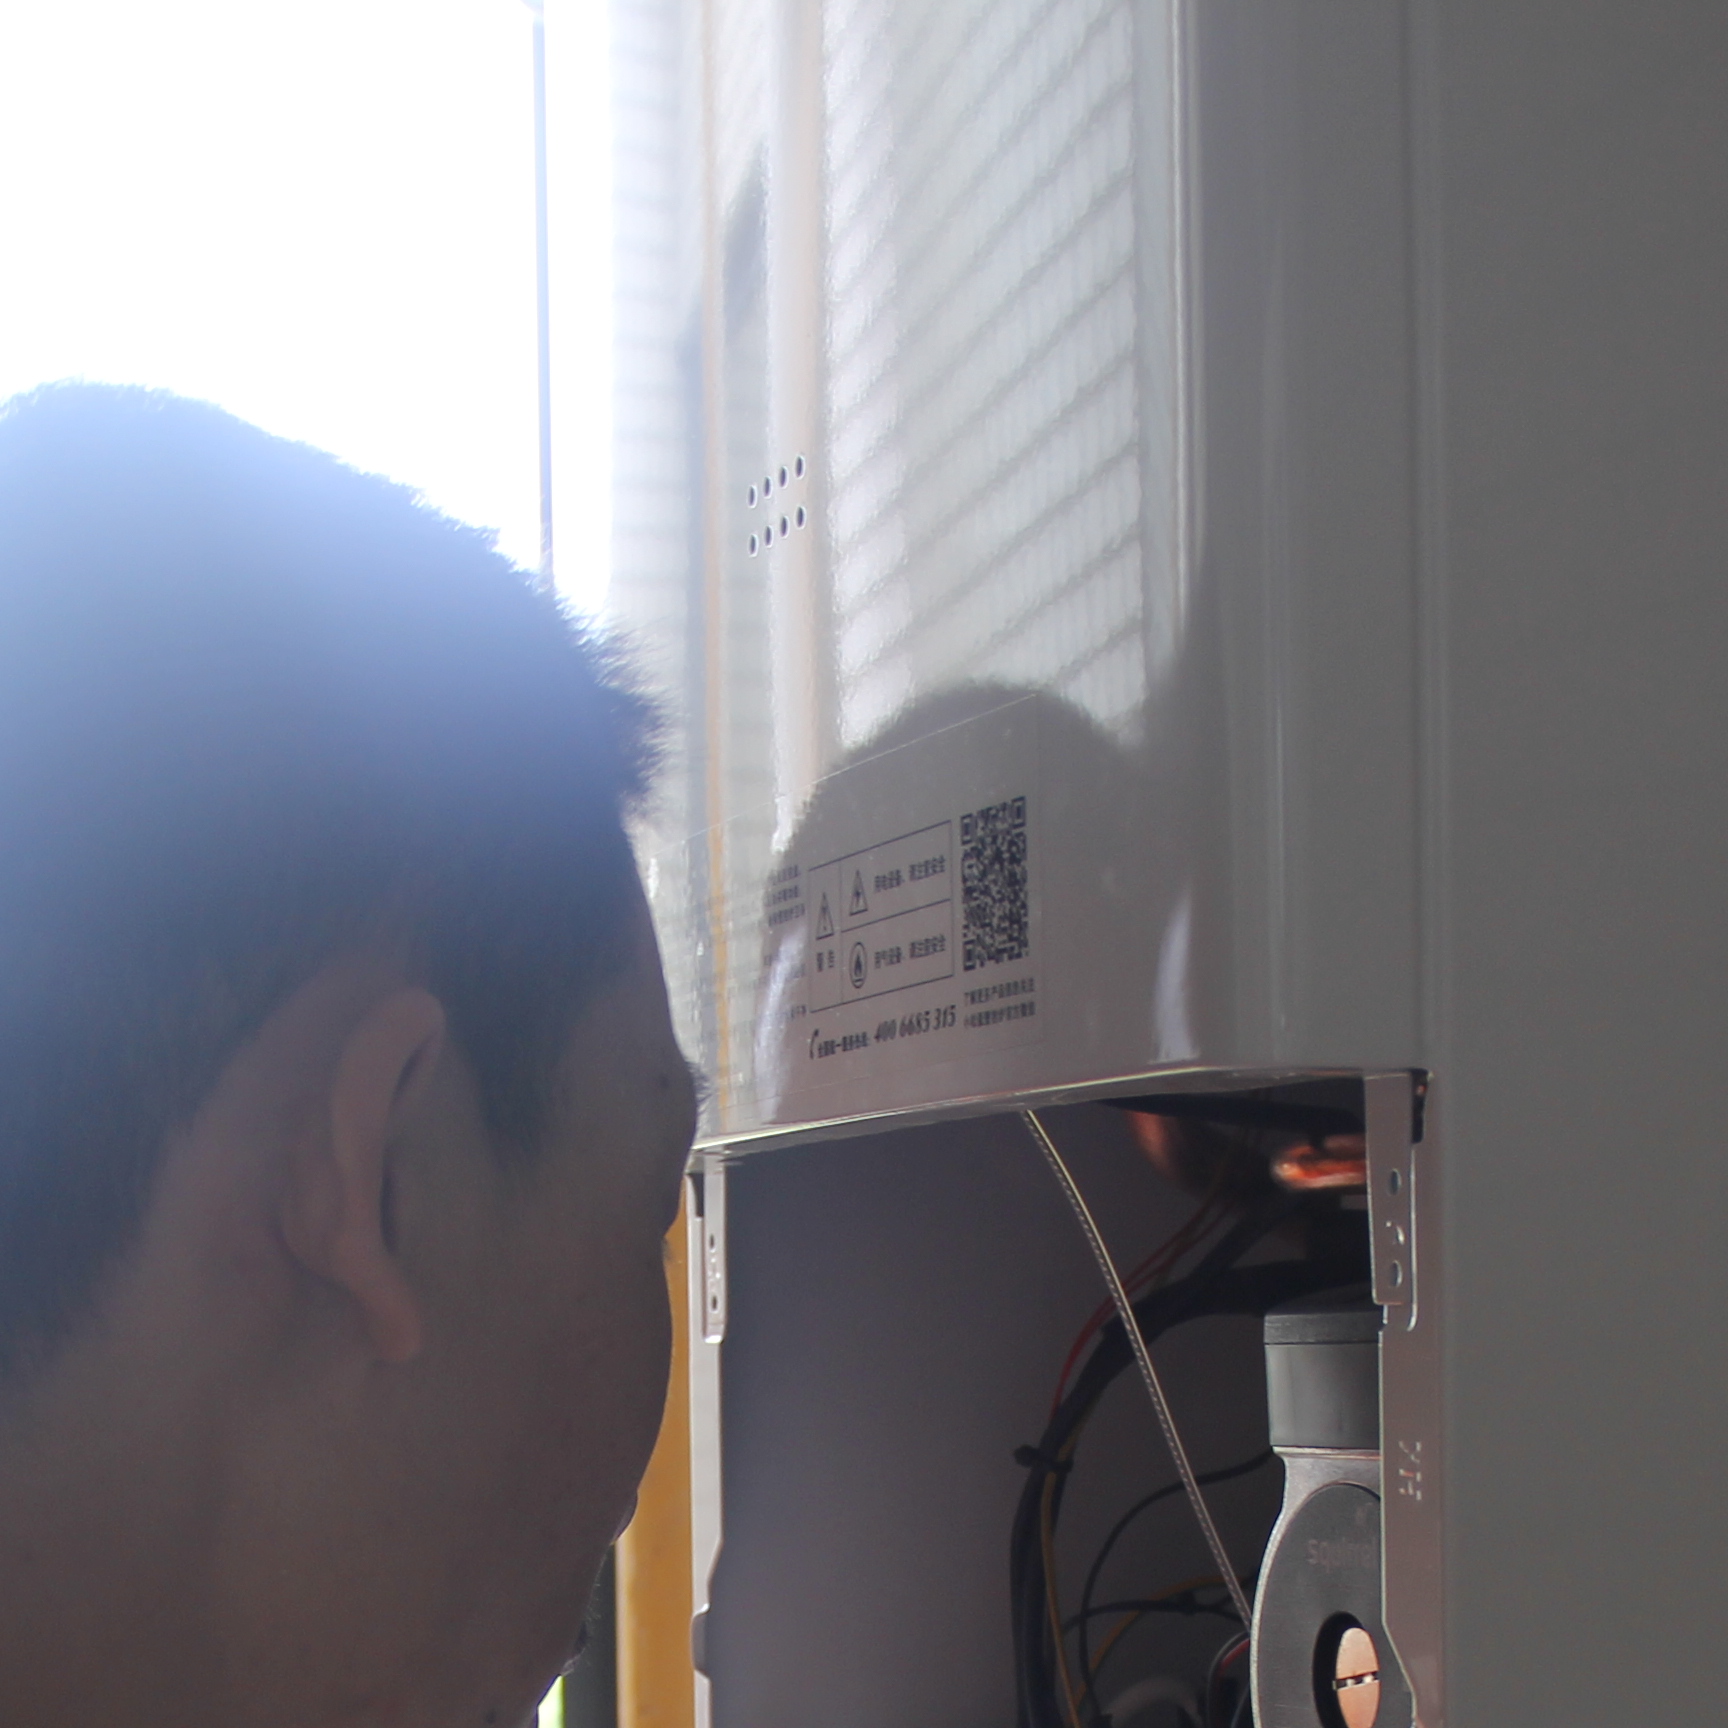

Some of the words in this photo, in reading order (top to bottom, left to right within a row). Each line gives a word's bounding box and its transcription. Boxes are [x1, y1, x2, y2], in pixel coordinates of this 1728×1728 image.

[873, 1019, 897, 1044] 400
[900, 1012, 932, 1039] 6685
[933, 1005, 957, 1030] 315
